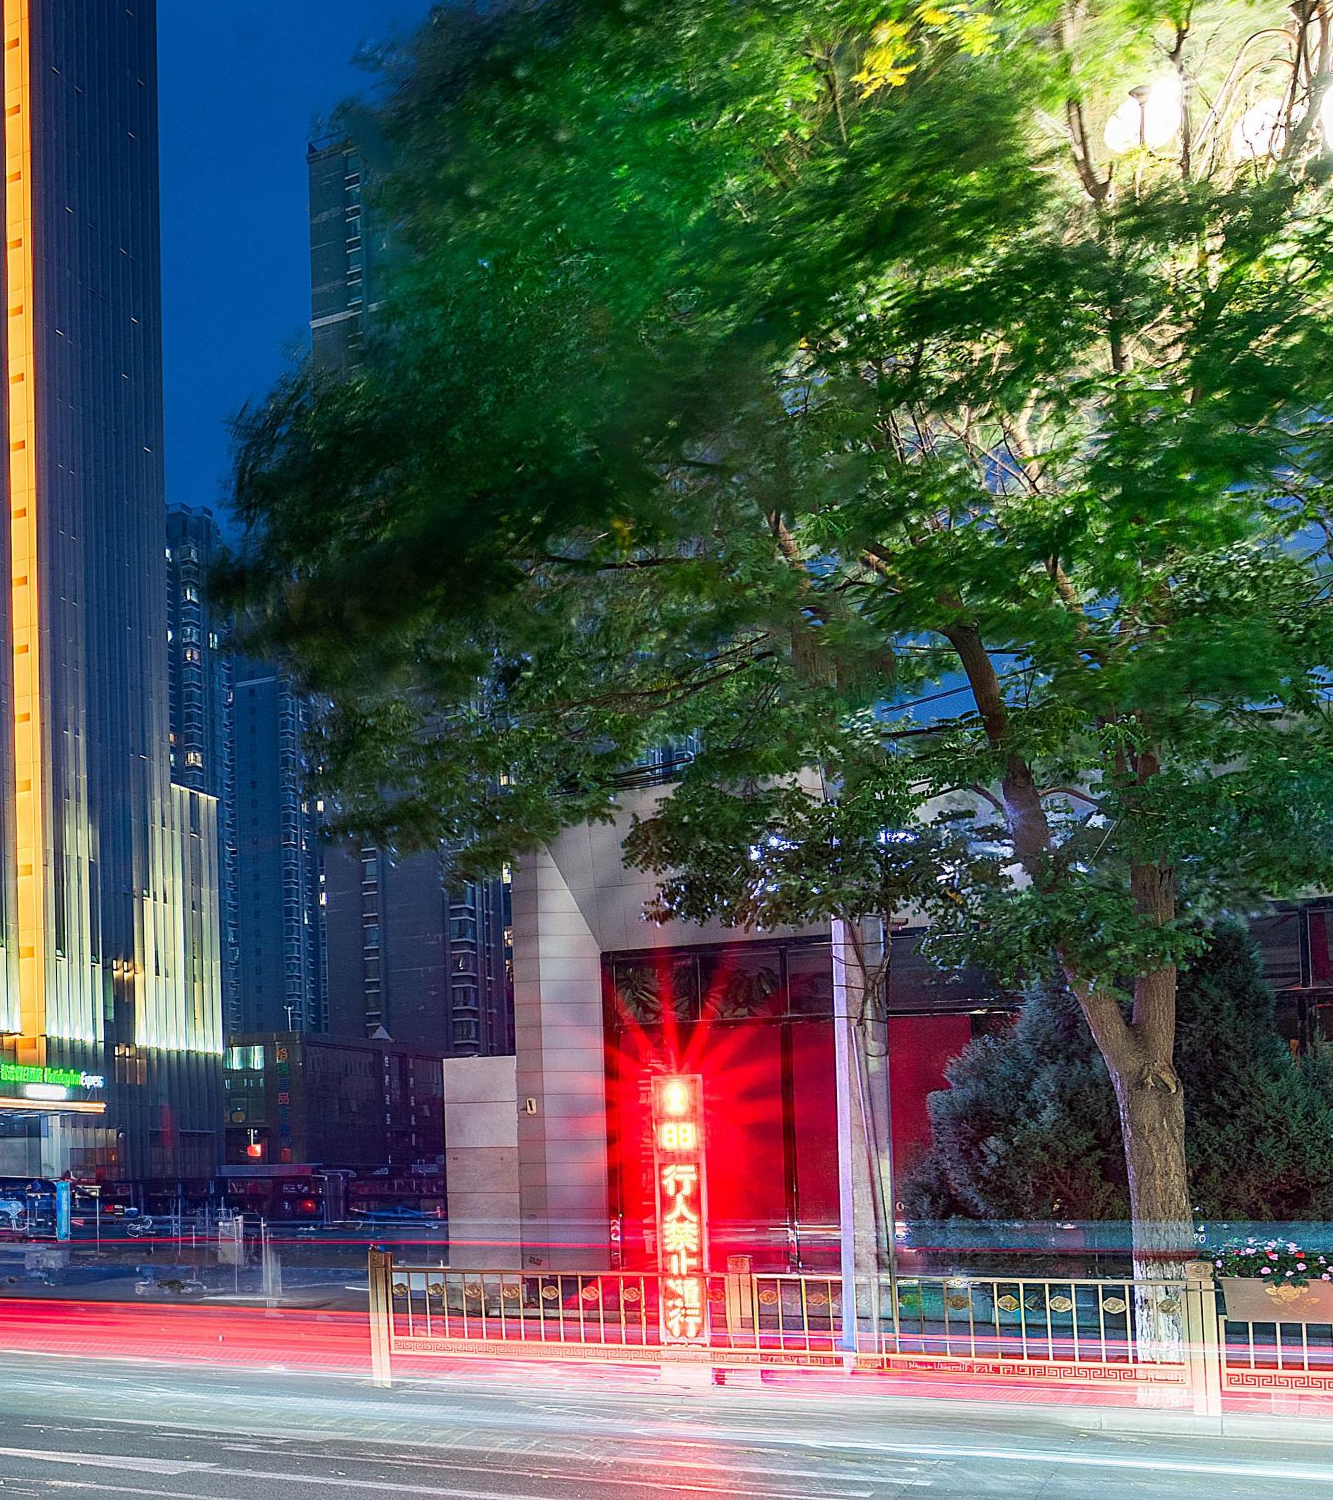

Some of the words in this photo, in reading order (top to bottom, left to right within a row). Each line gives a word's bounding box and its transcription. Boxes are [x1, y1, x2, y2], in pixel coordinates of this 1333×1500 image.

[662, 1164, 702, 1339] 行人禁止通行
